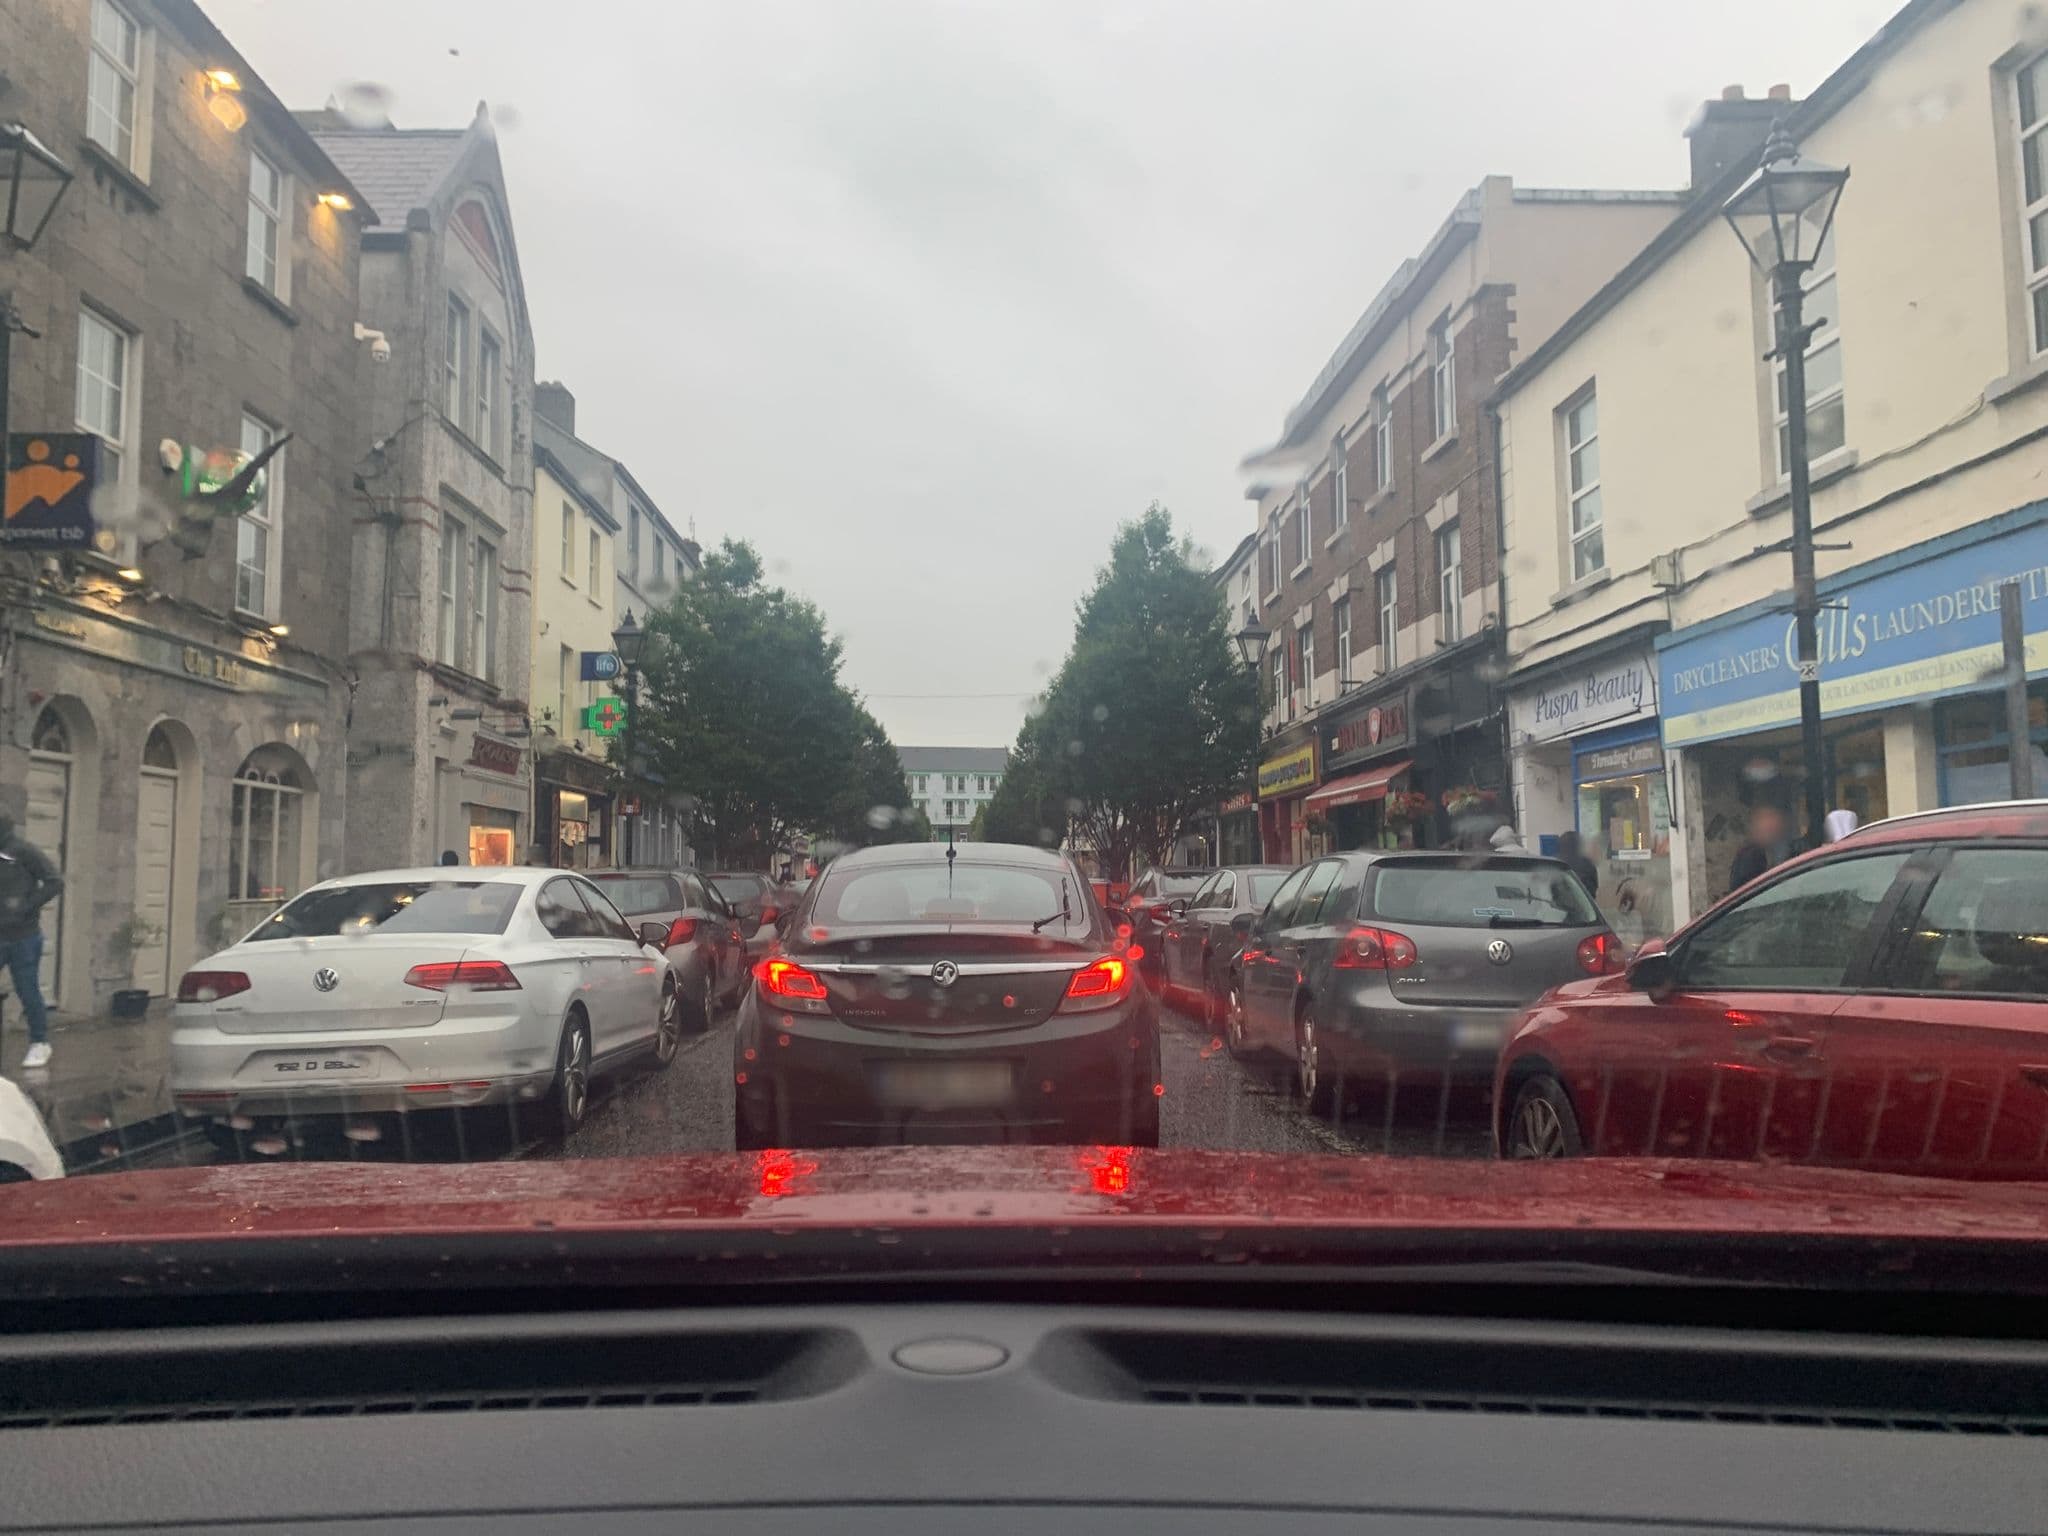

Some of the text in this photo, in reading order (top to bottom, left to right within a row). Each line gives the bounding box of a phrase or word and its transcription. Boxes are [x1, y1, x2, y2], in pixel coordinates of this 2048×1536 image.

[1673, 644, 1781, 695] DRYCLEANERS
[1872, 566, 2048, 641] LAUNDERET
[596, 658, 615, 672] life
[1535, 667, 1644, 726] Puspa Beauty
